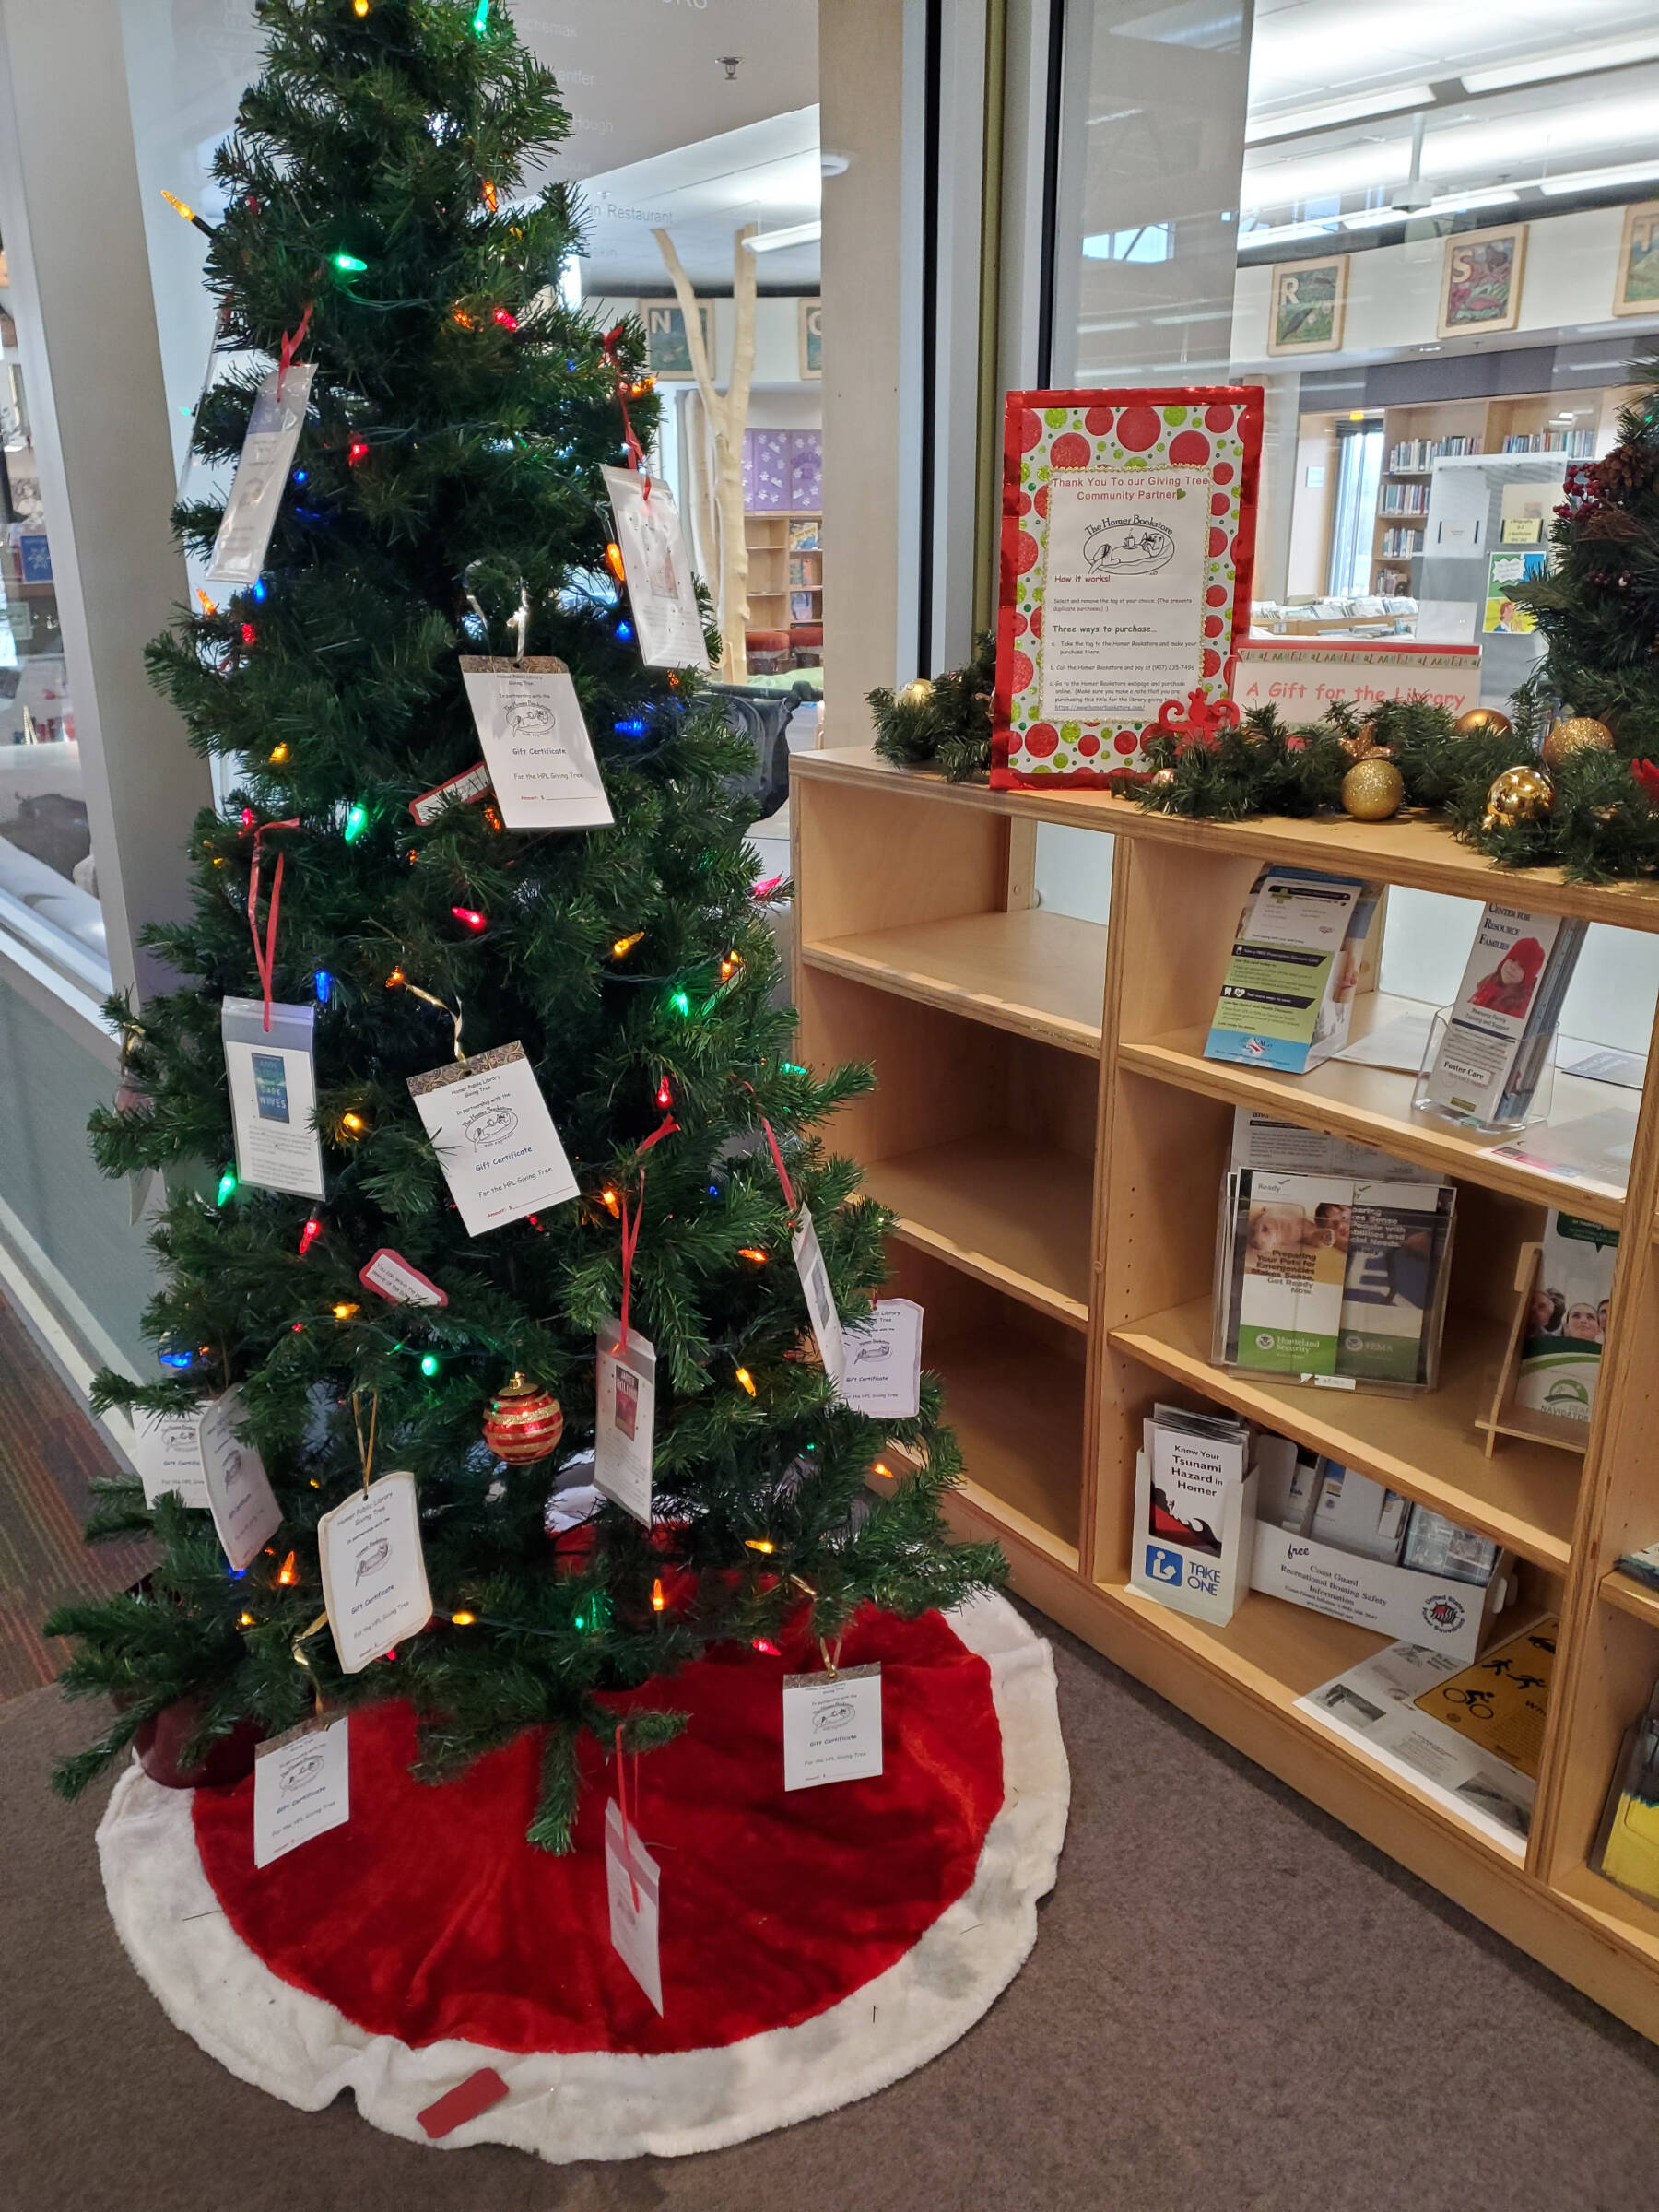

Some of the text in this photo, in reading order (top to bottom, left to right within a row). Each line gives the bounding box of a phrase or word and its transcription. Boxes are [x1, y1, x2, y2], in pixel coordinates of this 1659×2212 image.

[607, 205, 674, 224] Restaurant
[1453, 251, 1473, 283] S
[1280, 277, 1299, 305] R
[651, 311, 671, 334] N
[1053, 477, 1083, 488] Thank
[1088, 477, 1107, 487] You
[1111, 477, 1124, 487] To
[1148, 477, 1181, 487] Giving
[1185, 476, 1209, 485] Tree
[1077, 490, 1177, 501] Community Partner
[1084, 514, 1173, 536] The Homer Bookstore
[1246, 682, 1466, 711] A Gift for the Library
[512, 747, 566, 756] Gift Certificate
[550, 772, 569, 781] Giving
[1484, 917, 1521, 937] RESOURCE
[1478, 933, 1510, 951] FAMILIES
[1443, 1061, 1466, 1076] Foster
[482, 1075, 500, 1086] Library
[475, 1146, 533, 1172] Gift Certificate
[478, 1188, 491, 1199] For
[491, 1184, 502, 1194] the
[517, 1172, 537, 1185] Giving
[538, 1166, 553, 1177] Tree
[1257, 1182, 1281, 1194] Ready
[1256, 1254, 1316, 1268] Your Pets for
[1272, 1249, 1317, 1262] Preparing
[1251, 1267, 1284, 1279] Makes
[1255, 1262, 1315, 1276] Emergencies
[1267, 1277, 1313, 1289] Get Ready
[1276, 1343, 1312, 1354] Security
[1277, 1336, 1320, 1348] Homeland
[1174, 1444, 1219, 1461] Know Your
[1172, 1454, 1222, 1473] Tsunami
[1171, 1466, 1223, 1486] Hazard in
[1177, 1480, 1218, 1497] Homer
[1288, 1544, 1309, 1559] free
[1189, 1561, 1221, 1583] TAKE
[1310, 1565, 1359, 1587] Coast Guard
[1188, 1578, 1218, 1596] ONE
[1281, 1564, 1387, 1607] Recreational Boating Safety
[351, 1584, 394, 1615] Gift Certificate
[1309, 1584, 1355, 1606] Information
[825, 1735, 857, 1745] Certificate
